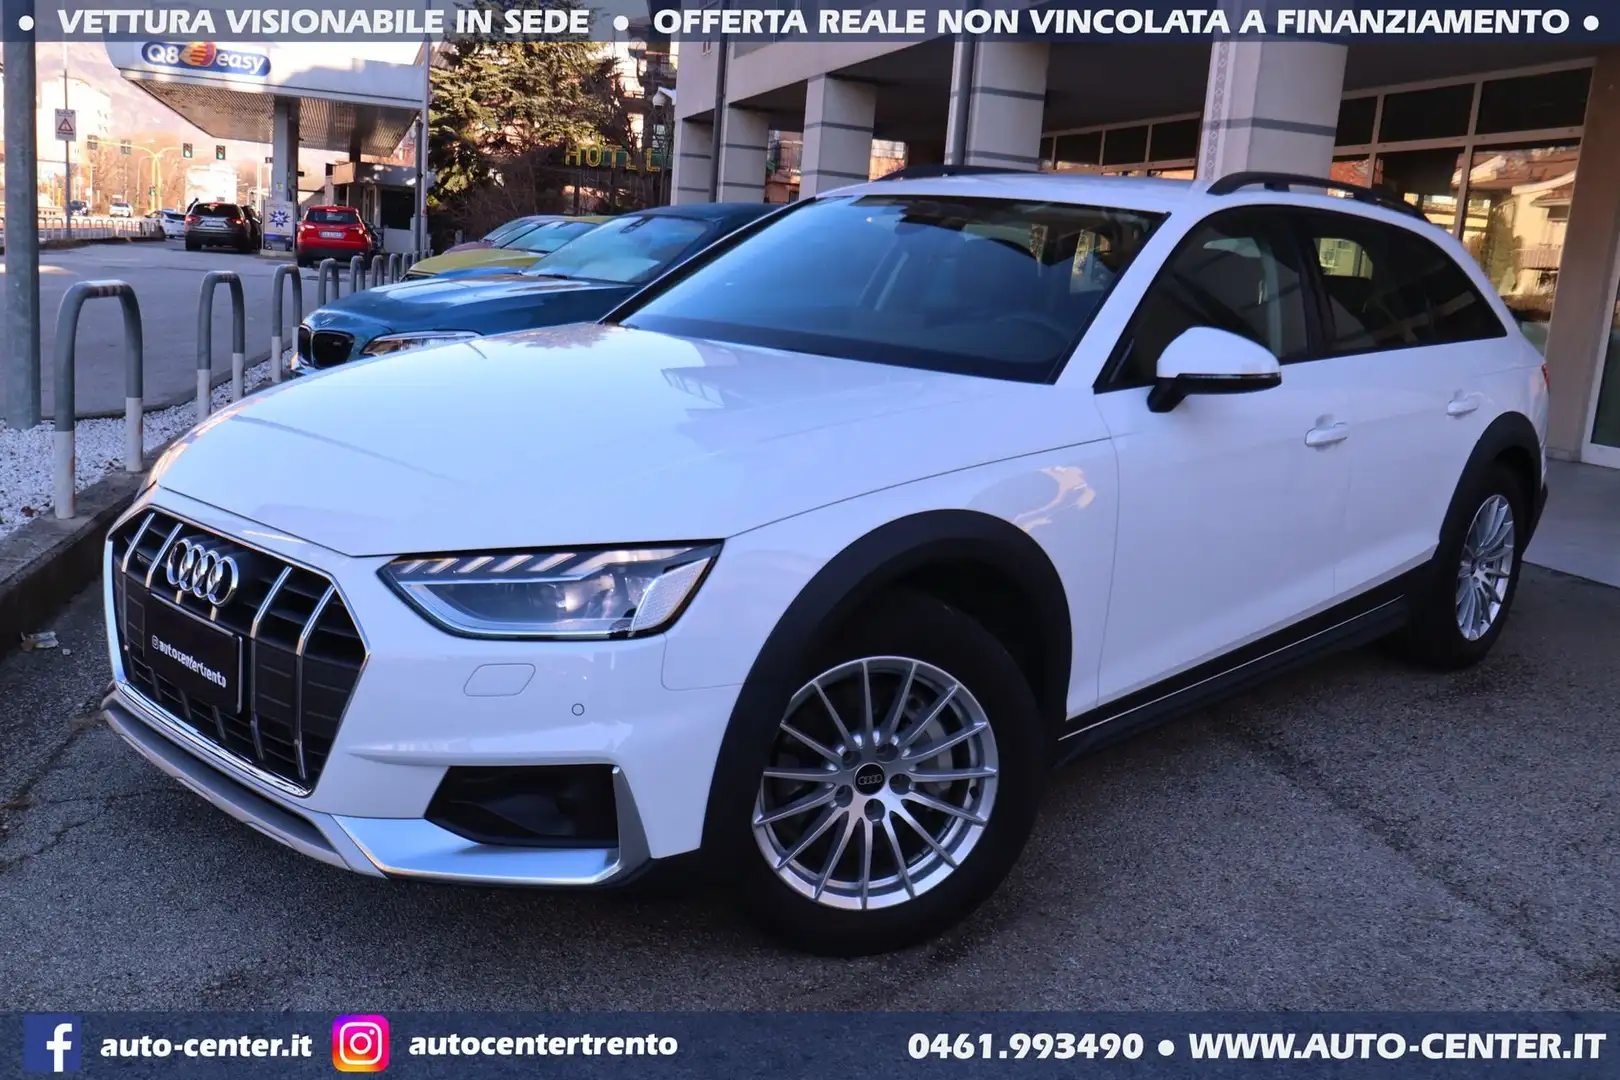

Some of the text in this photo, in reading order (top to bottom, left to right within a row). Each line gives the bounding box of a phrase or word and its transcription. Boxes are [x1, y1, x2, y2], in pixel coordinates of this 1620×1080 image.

[147, 44, 265, 74] Q8 easy
[159, 640, 227, 688] autocentertrento
